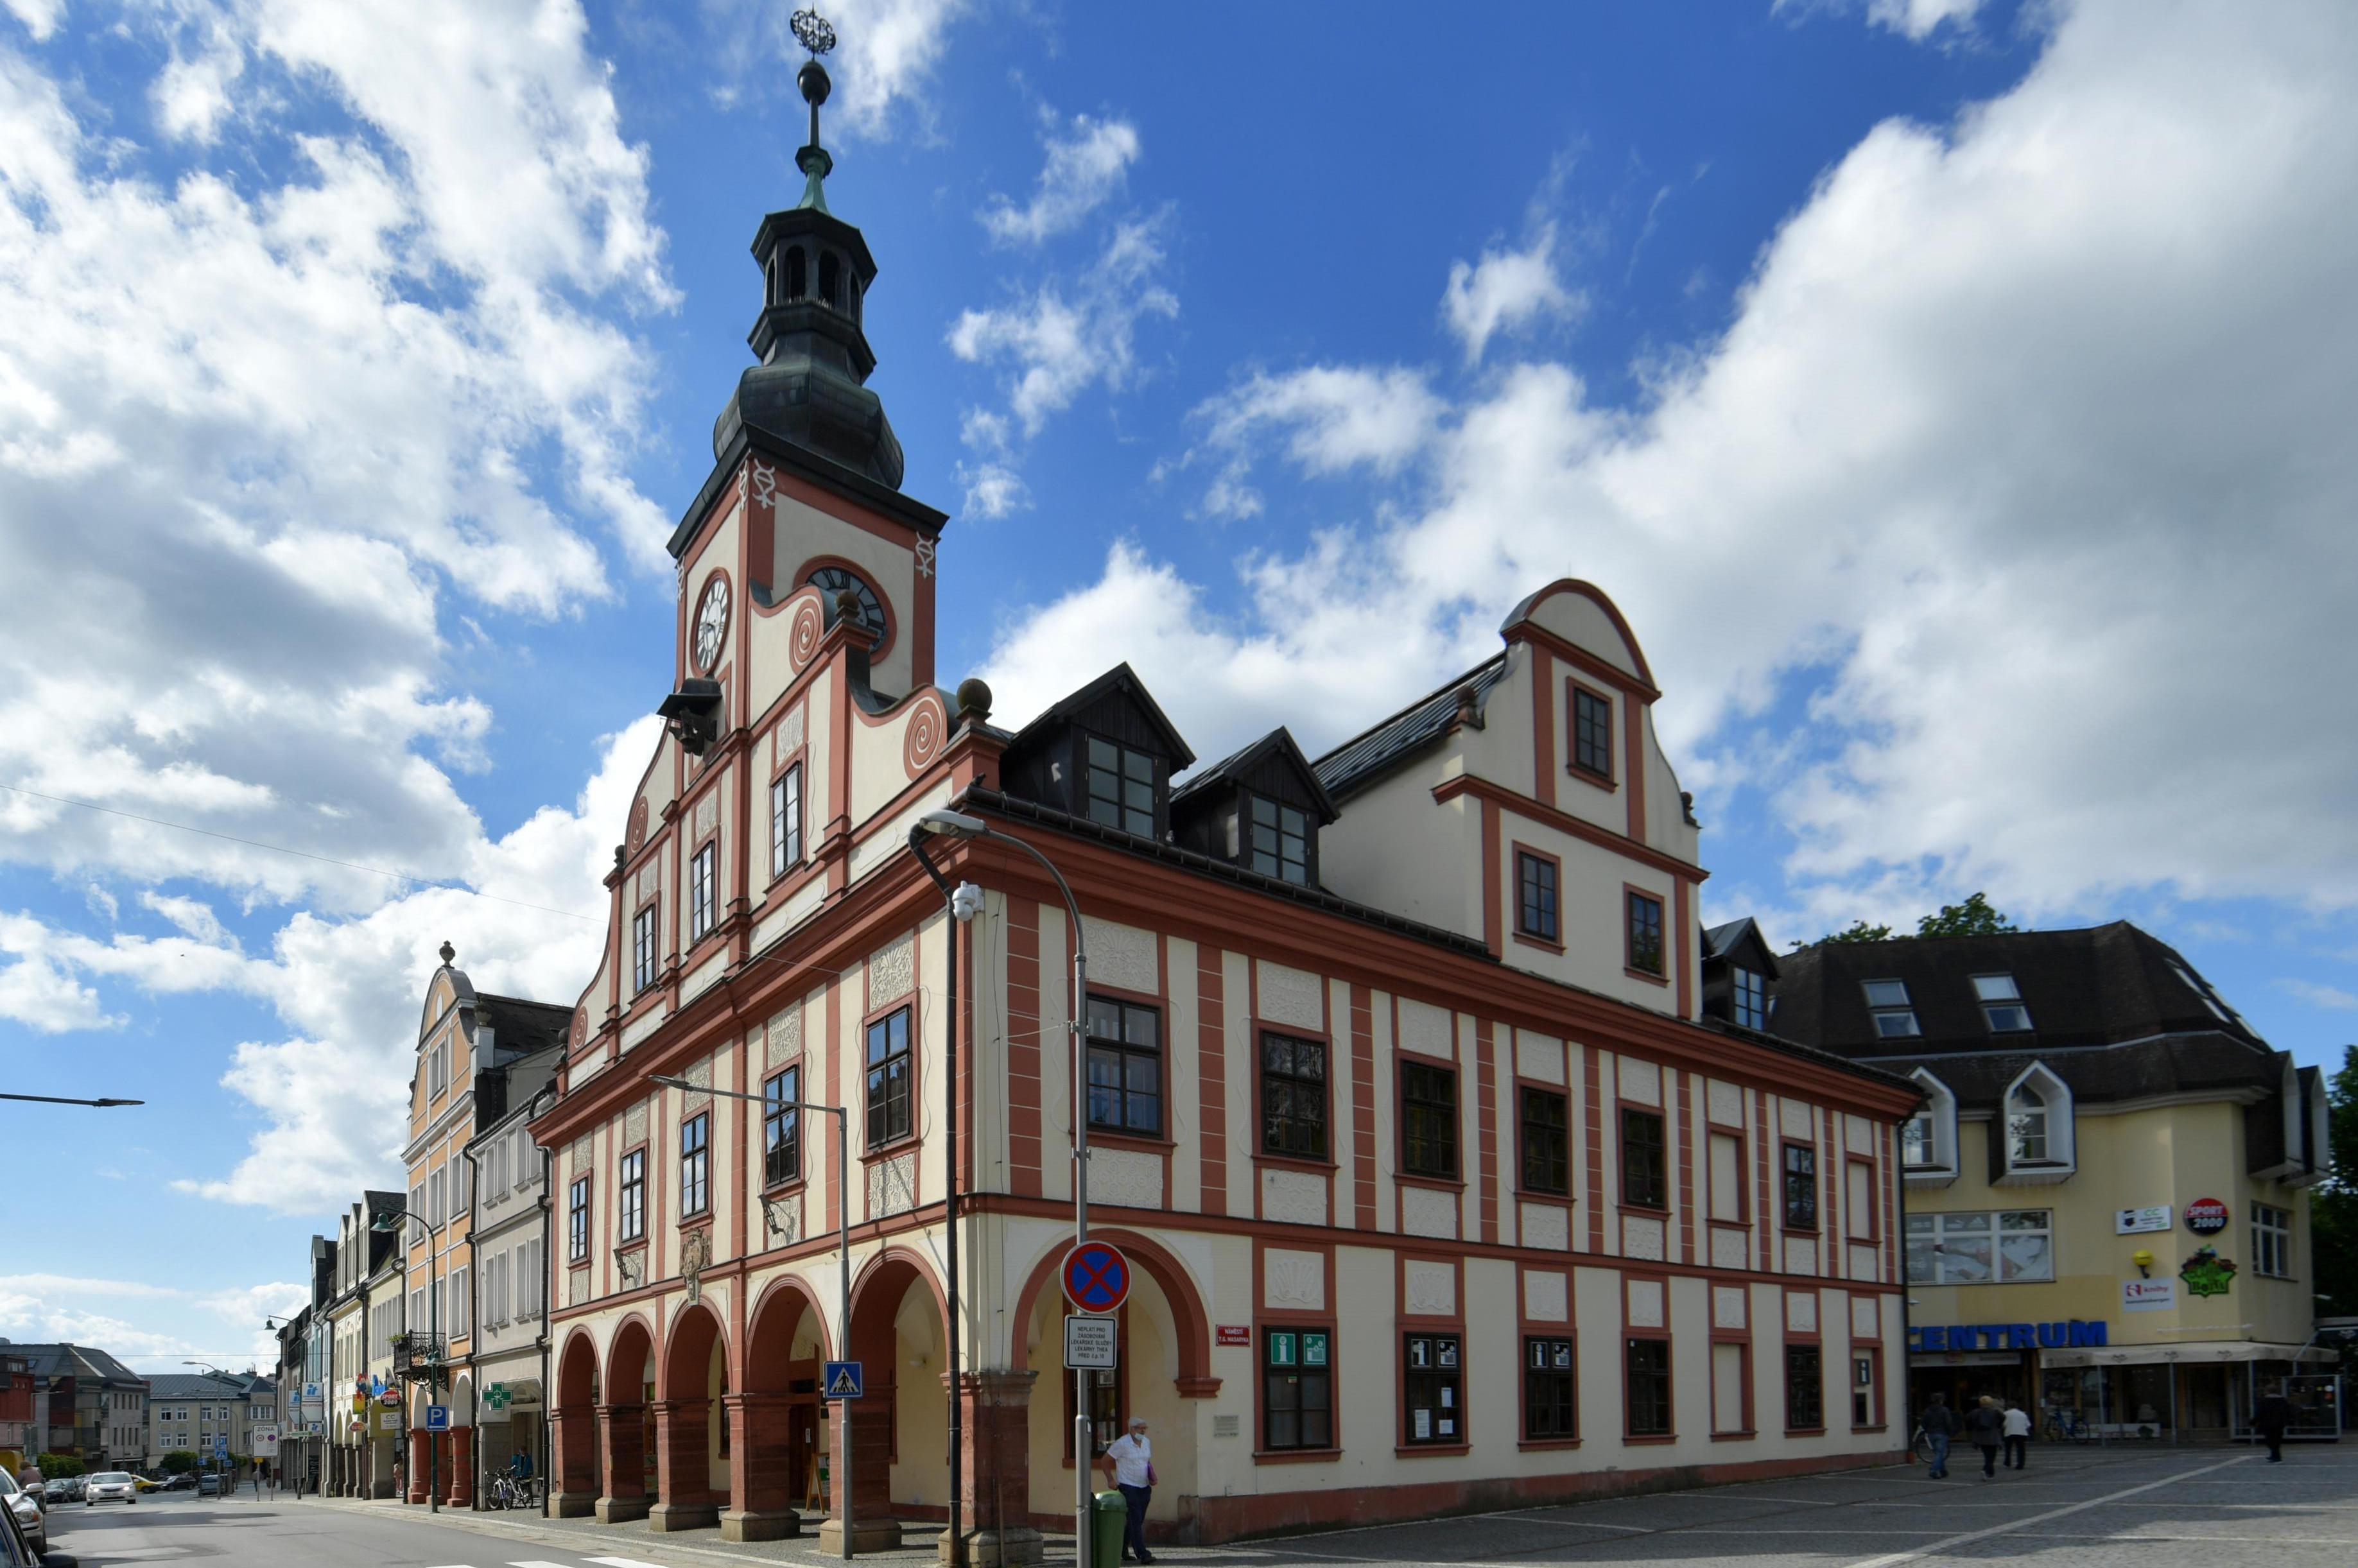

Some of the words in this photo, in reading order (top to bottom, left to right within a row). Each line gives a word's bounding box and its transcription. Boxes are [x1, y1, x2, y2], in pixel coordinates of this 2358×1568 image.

[2189, 1206, 2224, 1215] SPORT
[2193, 1218, 2224, 1228] 2000
[431, 1409, 443, 1423] P
